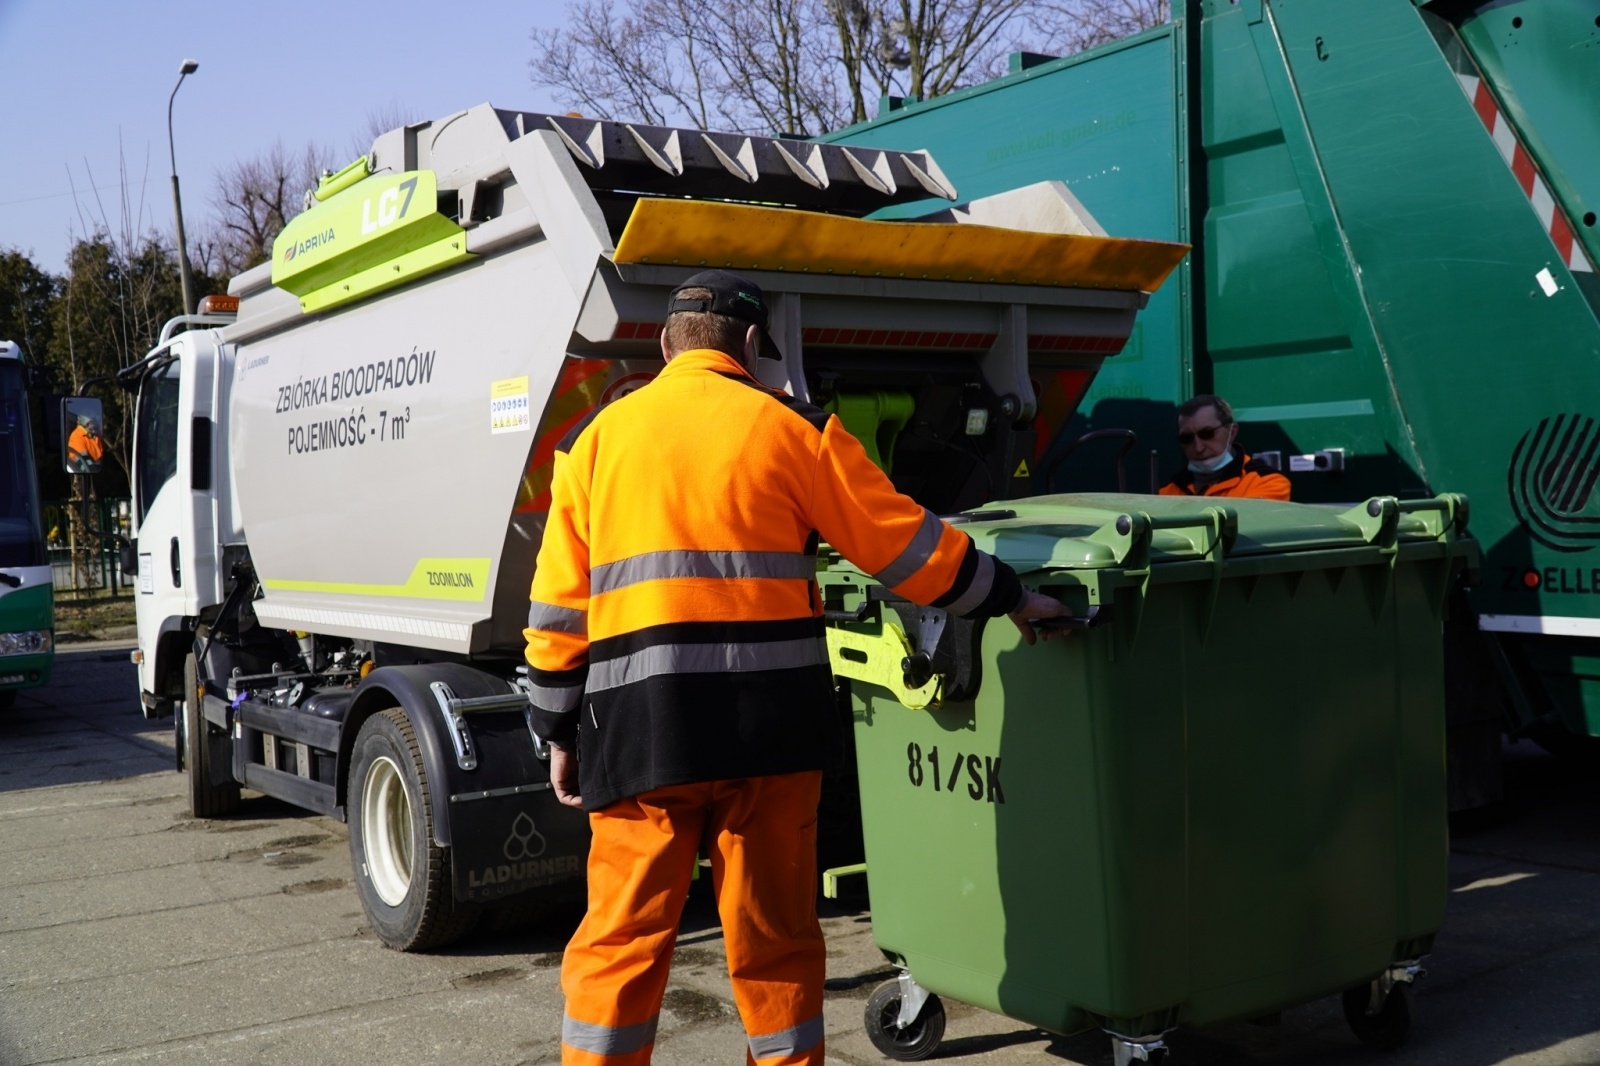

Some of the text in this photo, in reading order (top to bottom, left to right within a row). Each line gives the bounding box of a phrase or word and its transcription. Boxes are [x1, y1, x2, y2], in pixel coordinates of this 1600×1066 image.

[361, 176, 418, 236] LC7
[298, 228, 335, 256] APRIVA
[276, 346, 436, 413] ZBIÓRKA BIOODPADÓW
[288, 406, 366, 455] POJEMNOŚĆ
[379, 410, 387, 442] 7
[427, 571, 474, 588] ZOOMLION
[907, 742, 1005, 804] 81/SK
[468, 854, 579, 887] LADURNER
